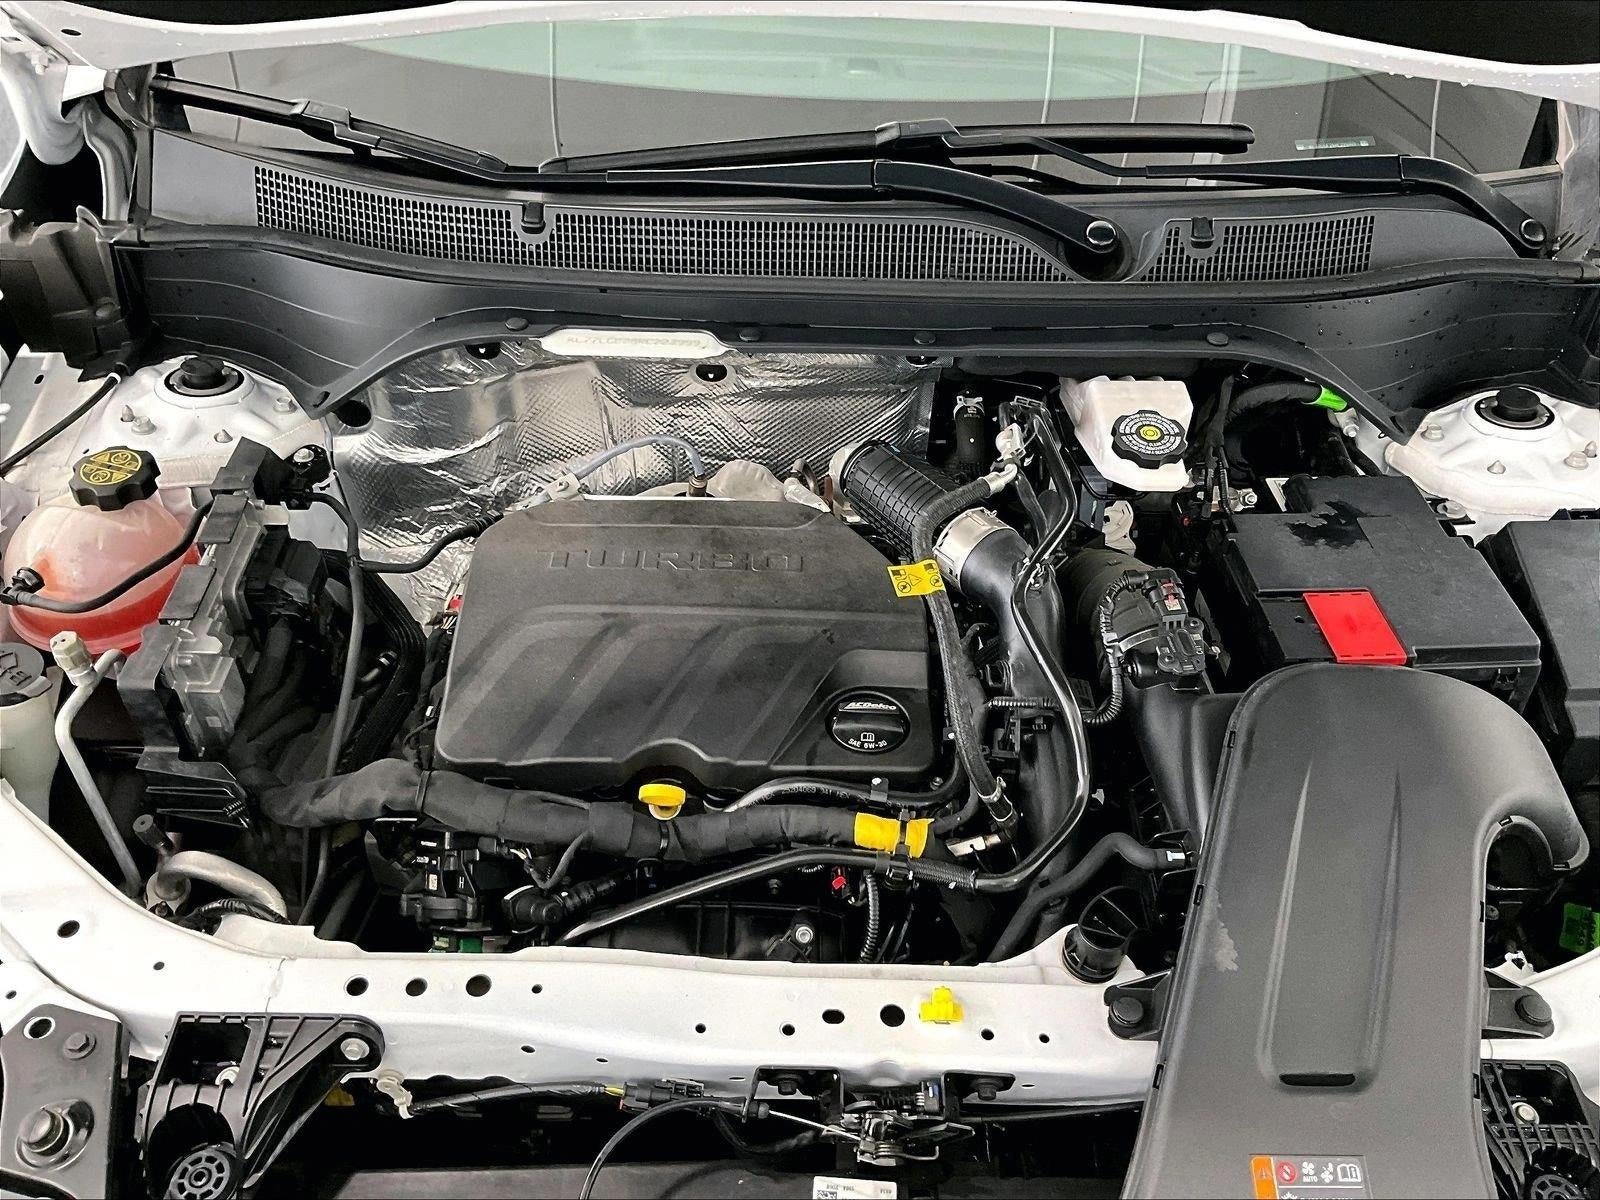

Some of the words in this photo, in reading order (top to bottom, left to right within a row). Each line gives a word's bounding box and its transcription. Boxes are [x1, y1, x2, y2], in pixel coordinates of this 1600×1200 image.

[536, 549, 804, 573] TURBO
[843, 701, 897, 711] ACDelco
[847, 738, 862, 748] SAE
[1302, 1175, 1319, 1183] AUTO
